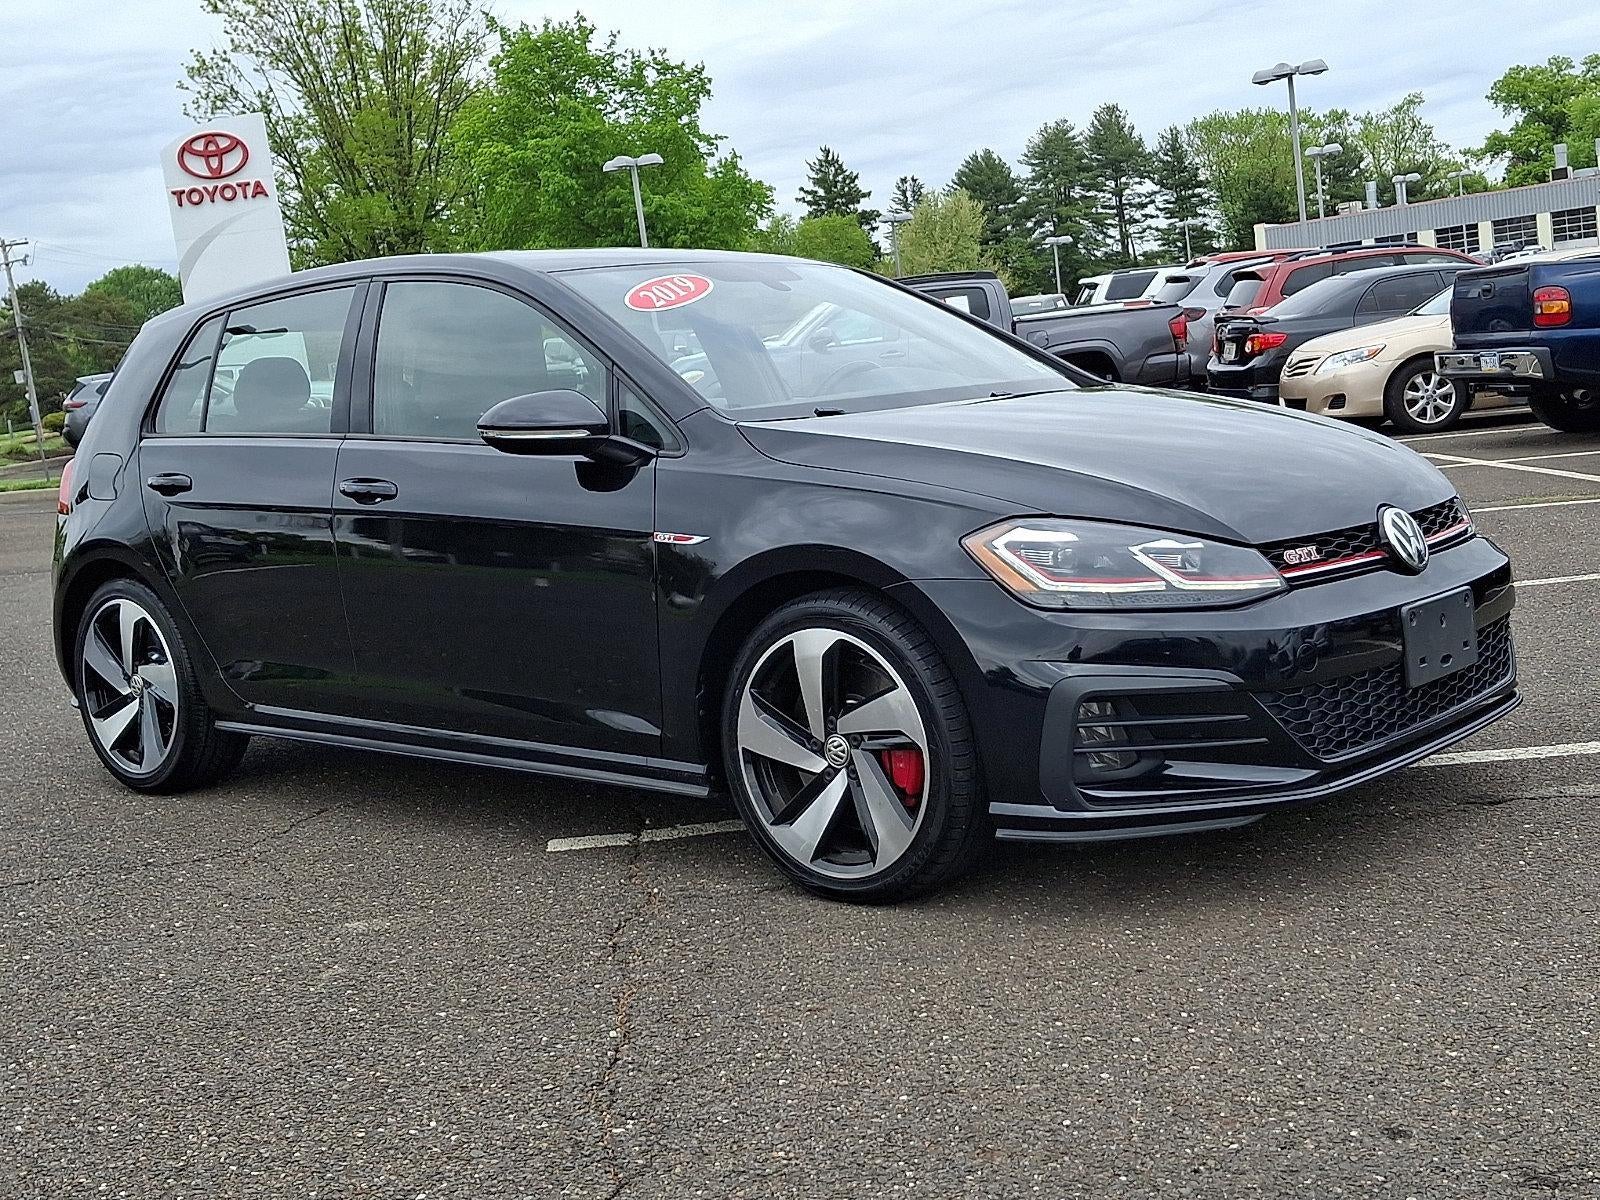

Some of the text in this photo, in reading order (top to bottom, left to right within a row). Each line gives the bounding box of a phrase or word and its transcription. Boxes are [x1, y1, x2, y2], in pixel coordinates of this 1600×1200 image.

[171, 180, 269, 207] TOYOTA
[640, 276, 695, 308] 2019
[656, 534, 674, 542] GTI
[1284, 546, 1320, 565] GTI
